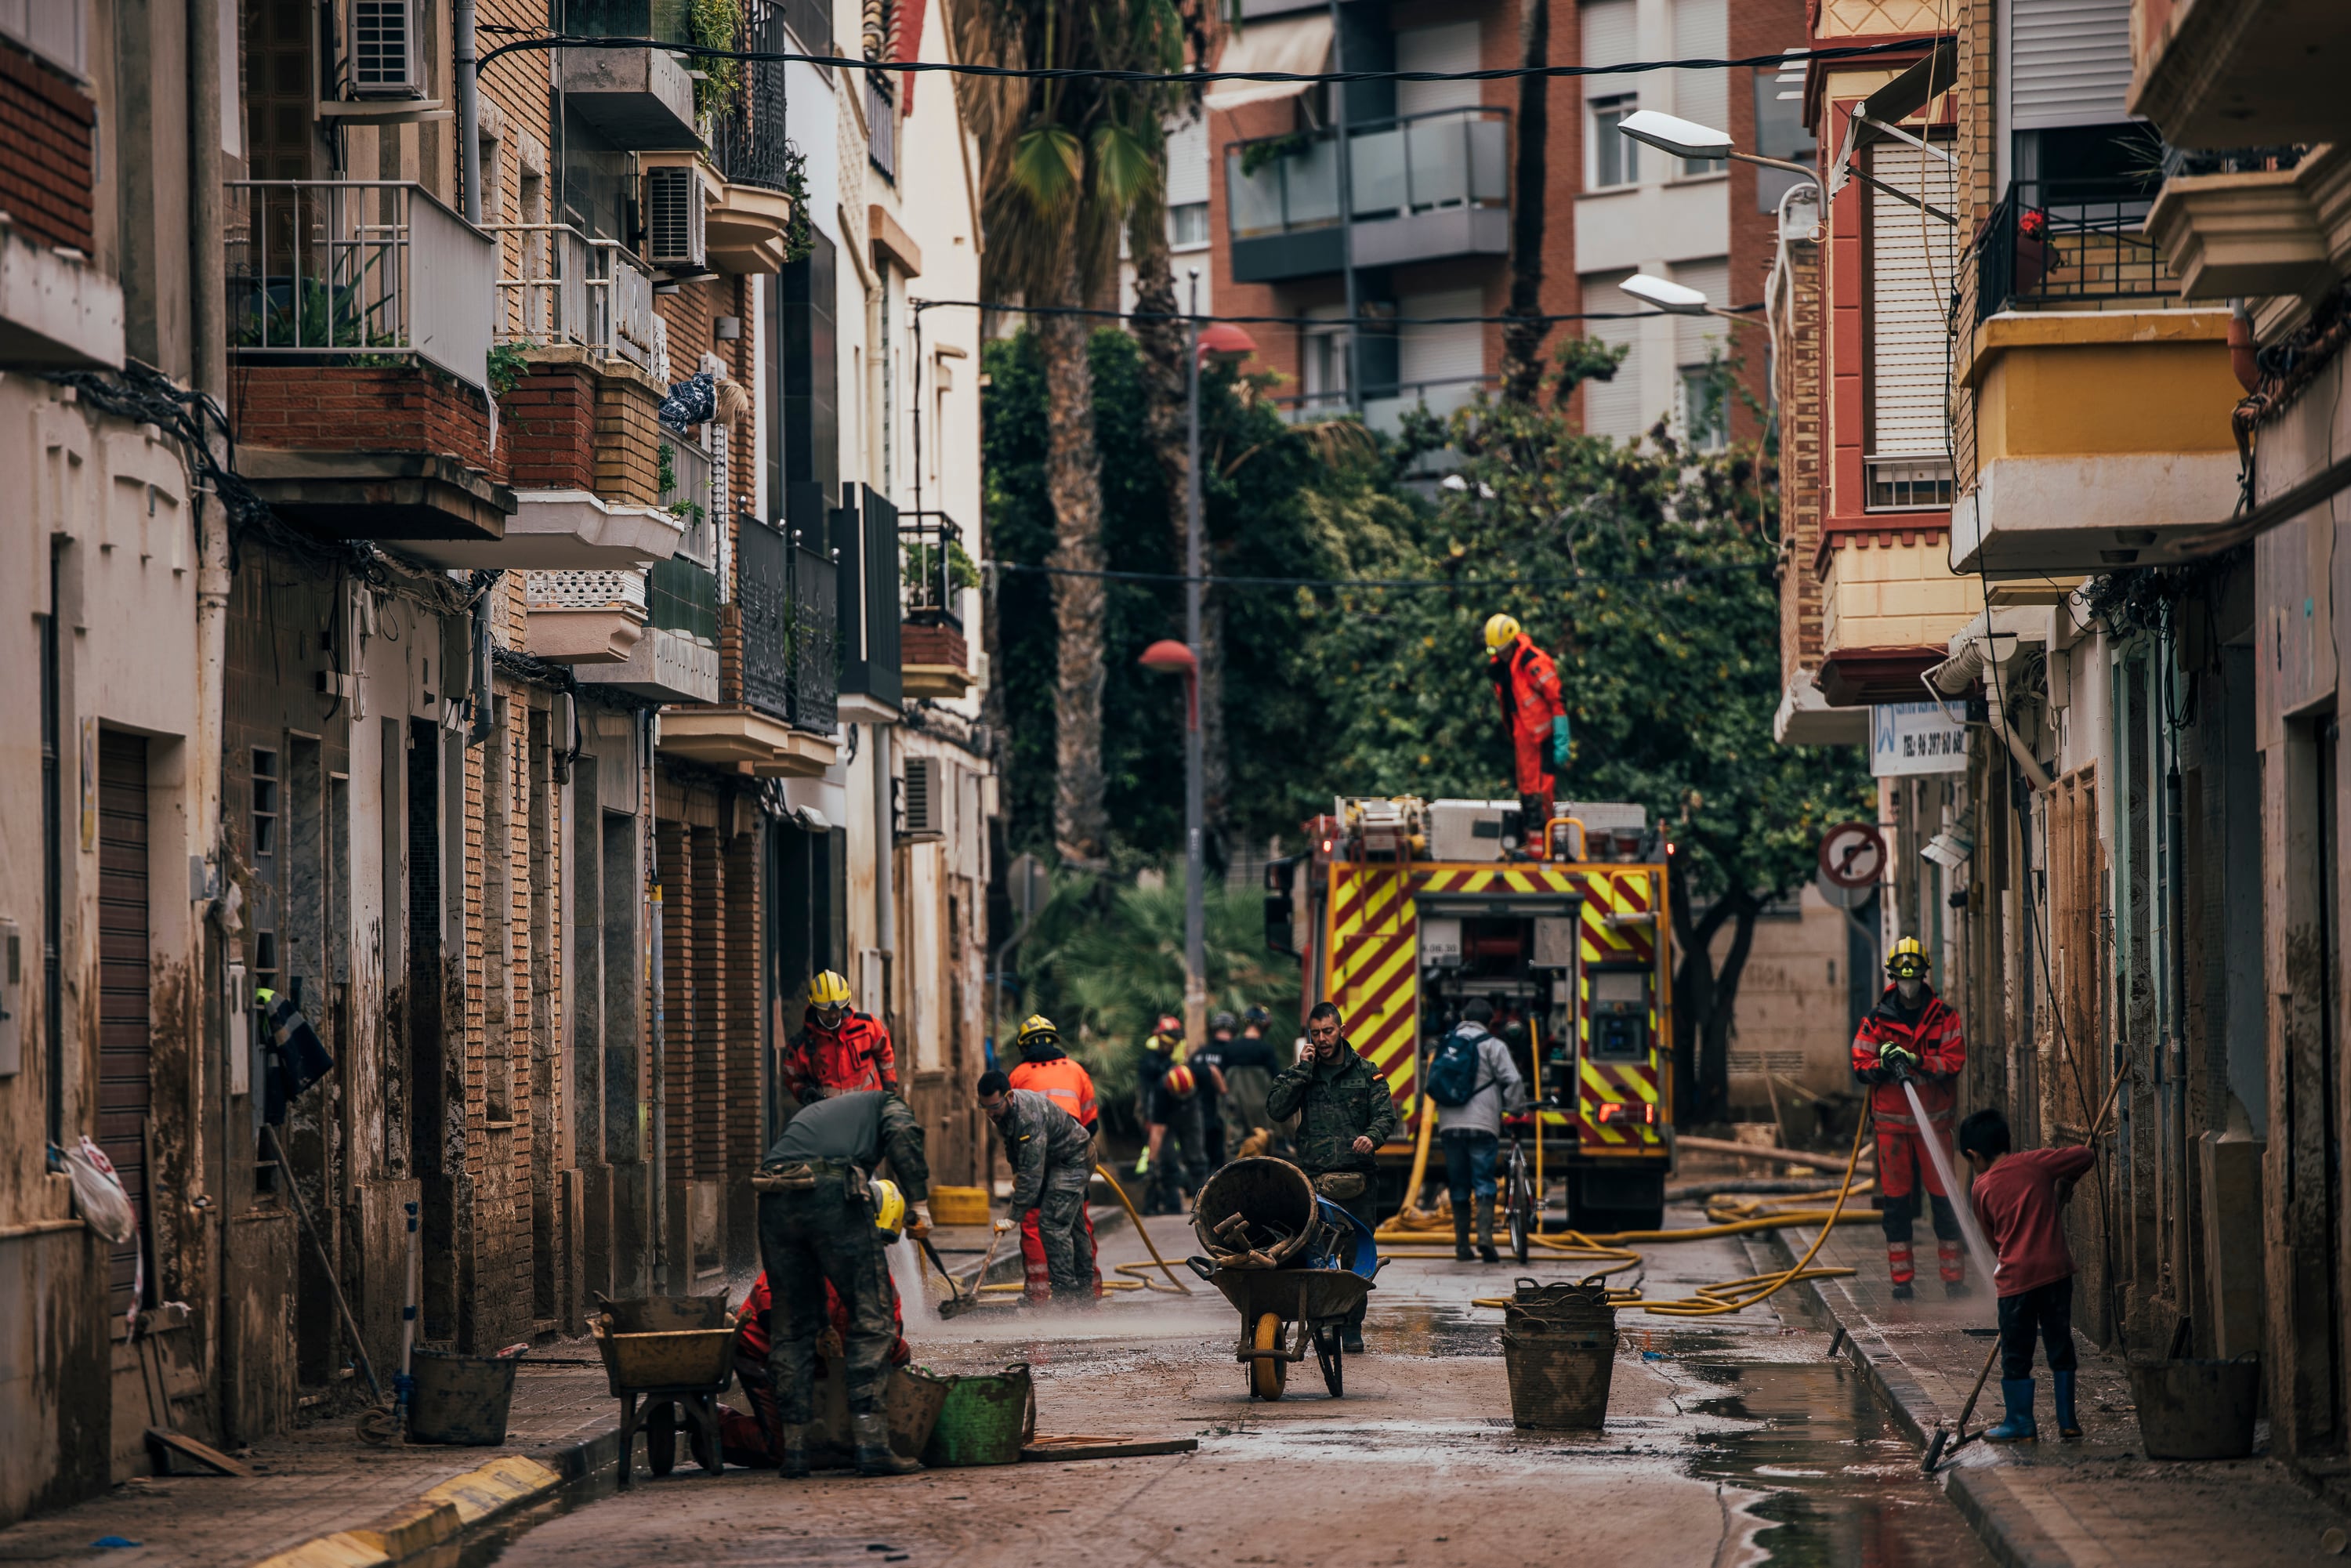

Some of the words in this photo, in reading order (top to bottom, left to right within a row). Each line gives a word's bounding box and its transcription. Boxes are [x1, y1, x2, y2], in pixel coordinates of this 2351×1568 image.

[1918, 733, 1926, 757] 96
[1928, 732, 1940, 756] 397
[1942, 730, 1951, 755] 60
